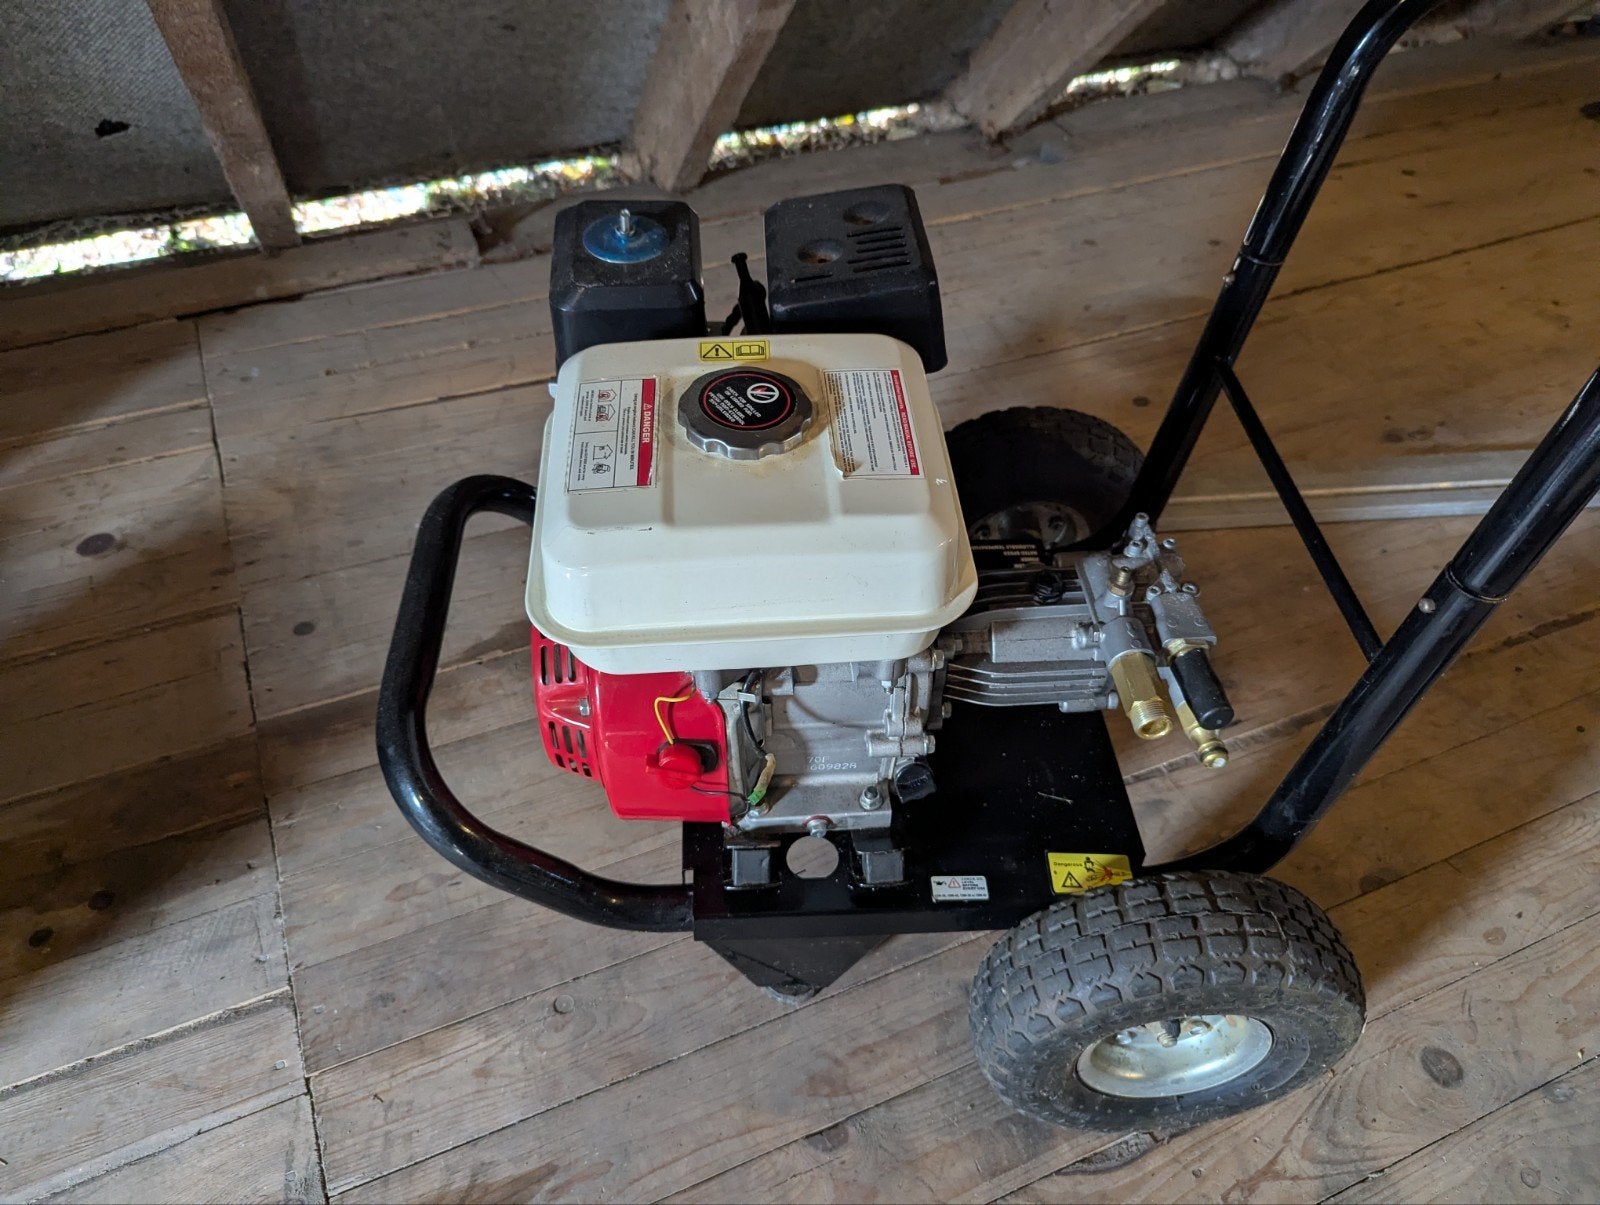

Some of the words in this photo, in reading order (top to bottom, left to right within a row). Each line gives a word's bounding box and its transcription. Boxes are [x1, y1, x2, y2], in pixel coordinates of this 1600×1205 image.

[726, 386, 738, 397] CHECK
[723, 399, 734, 408] ONLY
[642, 411, 652, 443] DANGER
